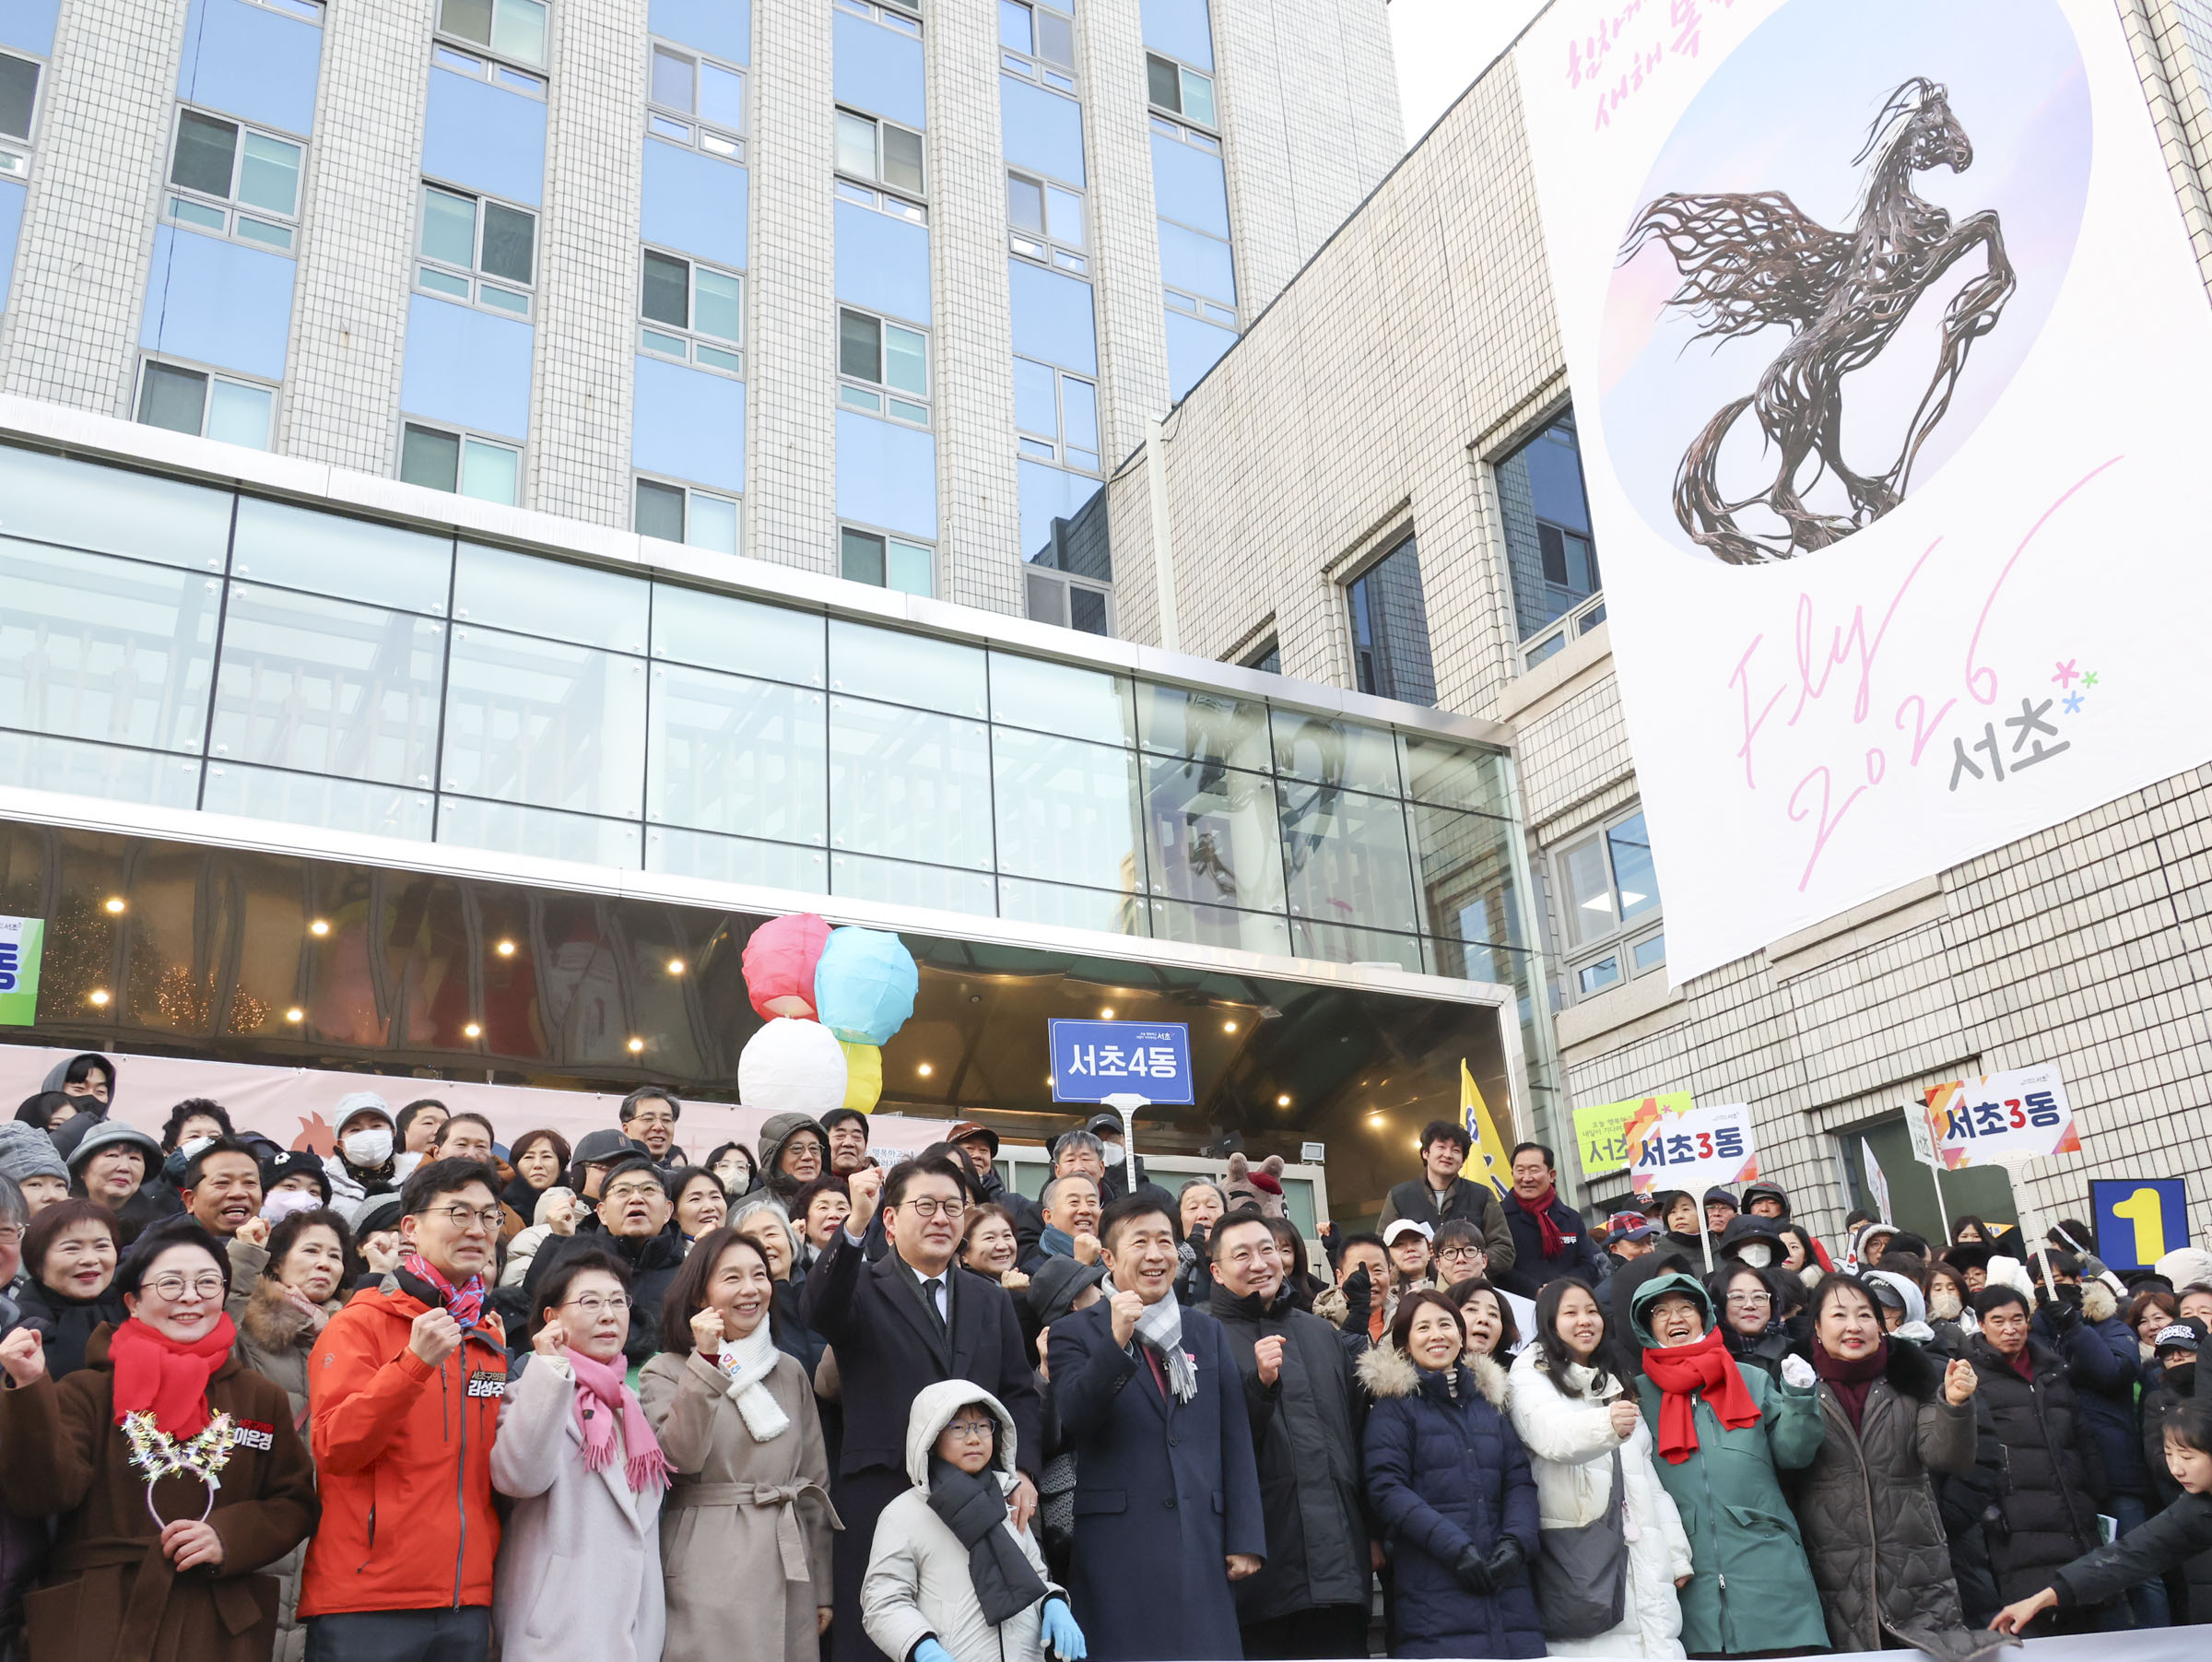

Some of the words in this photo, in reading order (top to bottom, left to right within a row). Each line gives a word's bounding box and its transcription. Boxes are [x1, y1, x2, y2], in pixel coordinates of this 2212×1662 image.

[1728, 536, 1944, 789] Fly
[1787, 454, 2125, 892] 2026
[1948, 697, 2071, 793] 서초
[1067, 1043, 1177, 1079] 서초4동
[1947, 1090, 2061, 1140] 서초3동
[1638, 1126, 1744, 1167] 서초3동
[2112, 1187, 2166, 1266] 1
[467, 1379, 506, 1397] 김성주
[233, 1427, 274, 1451] 이은경
